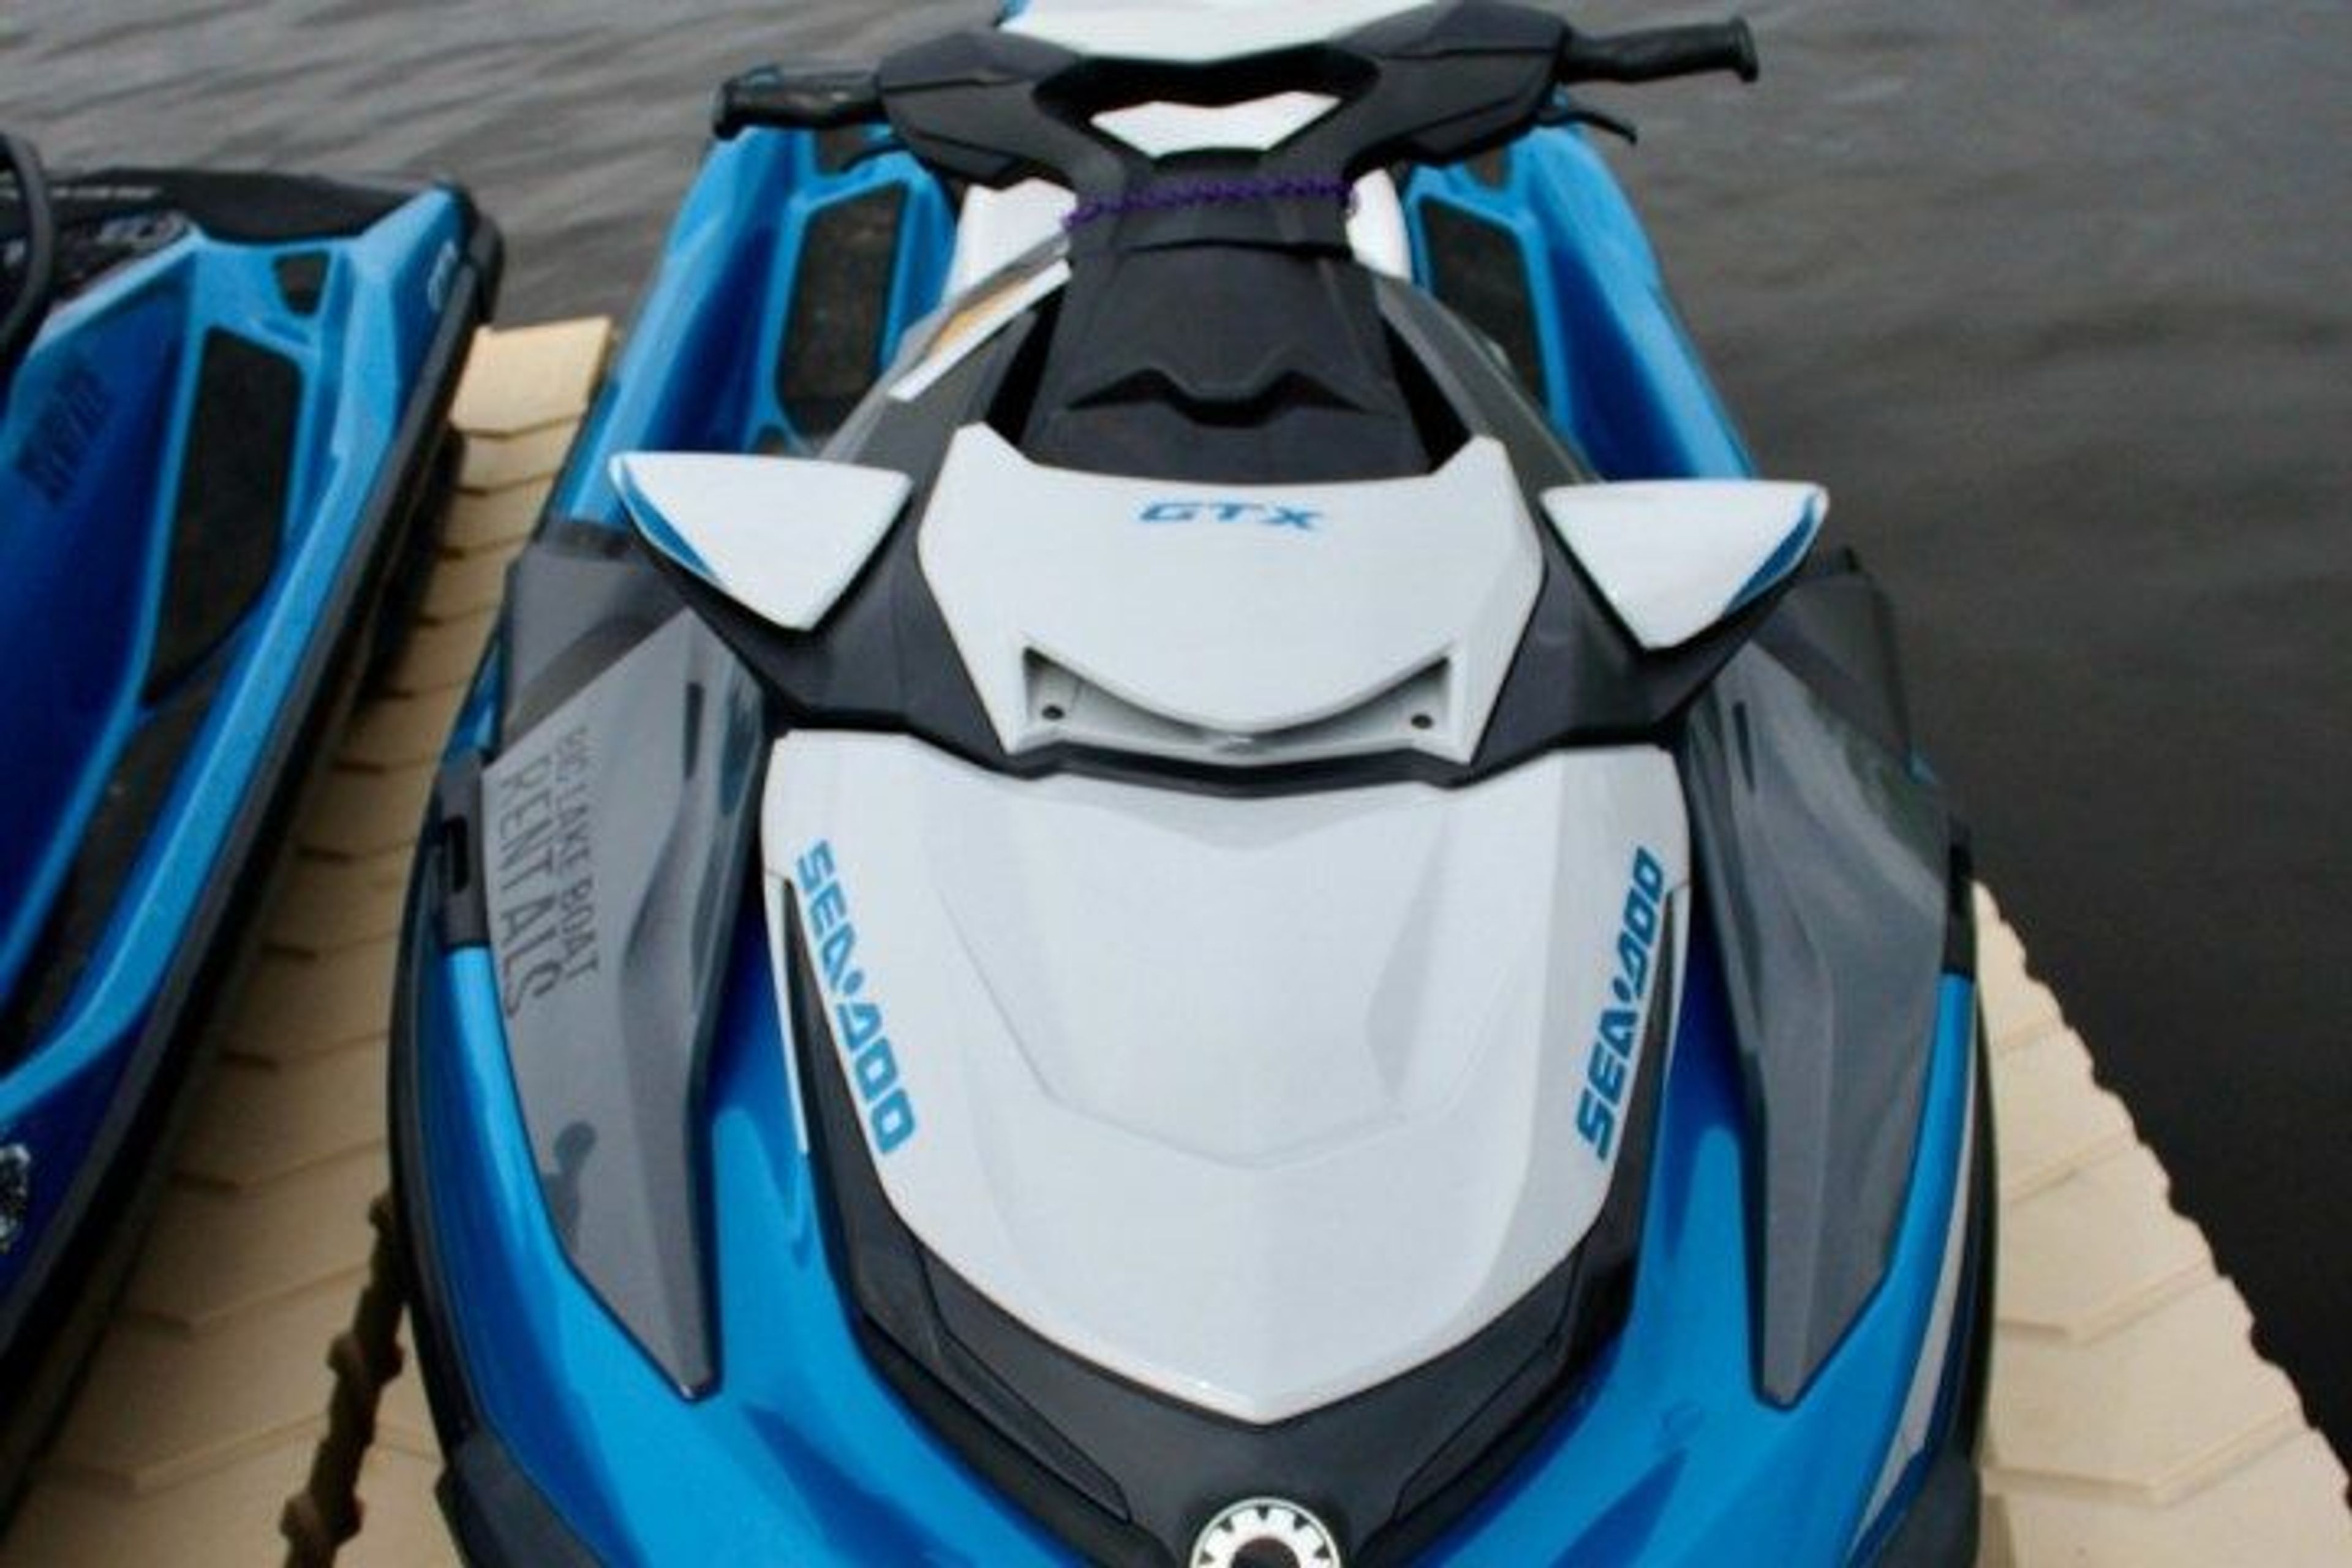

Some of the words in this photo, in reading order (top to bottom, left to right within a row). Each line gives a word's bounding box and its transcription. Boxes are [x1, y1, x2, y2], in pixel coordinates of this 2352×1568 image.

[1140, 502, 1322, 530] GTX
[499, 753, 564, 1018] RENTALS
[560, 876, 600, 981] BOAT
